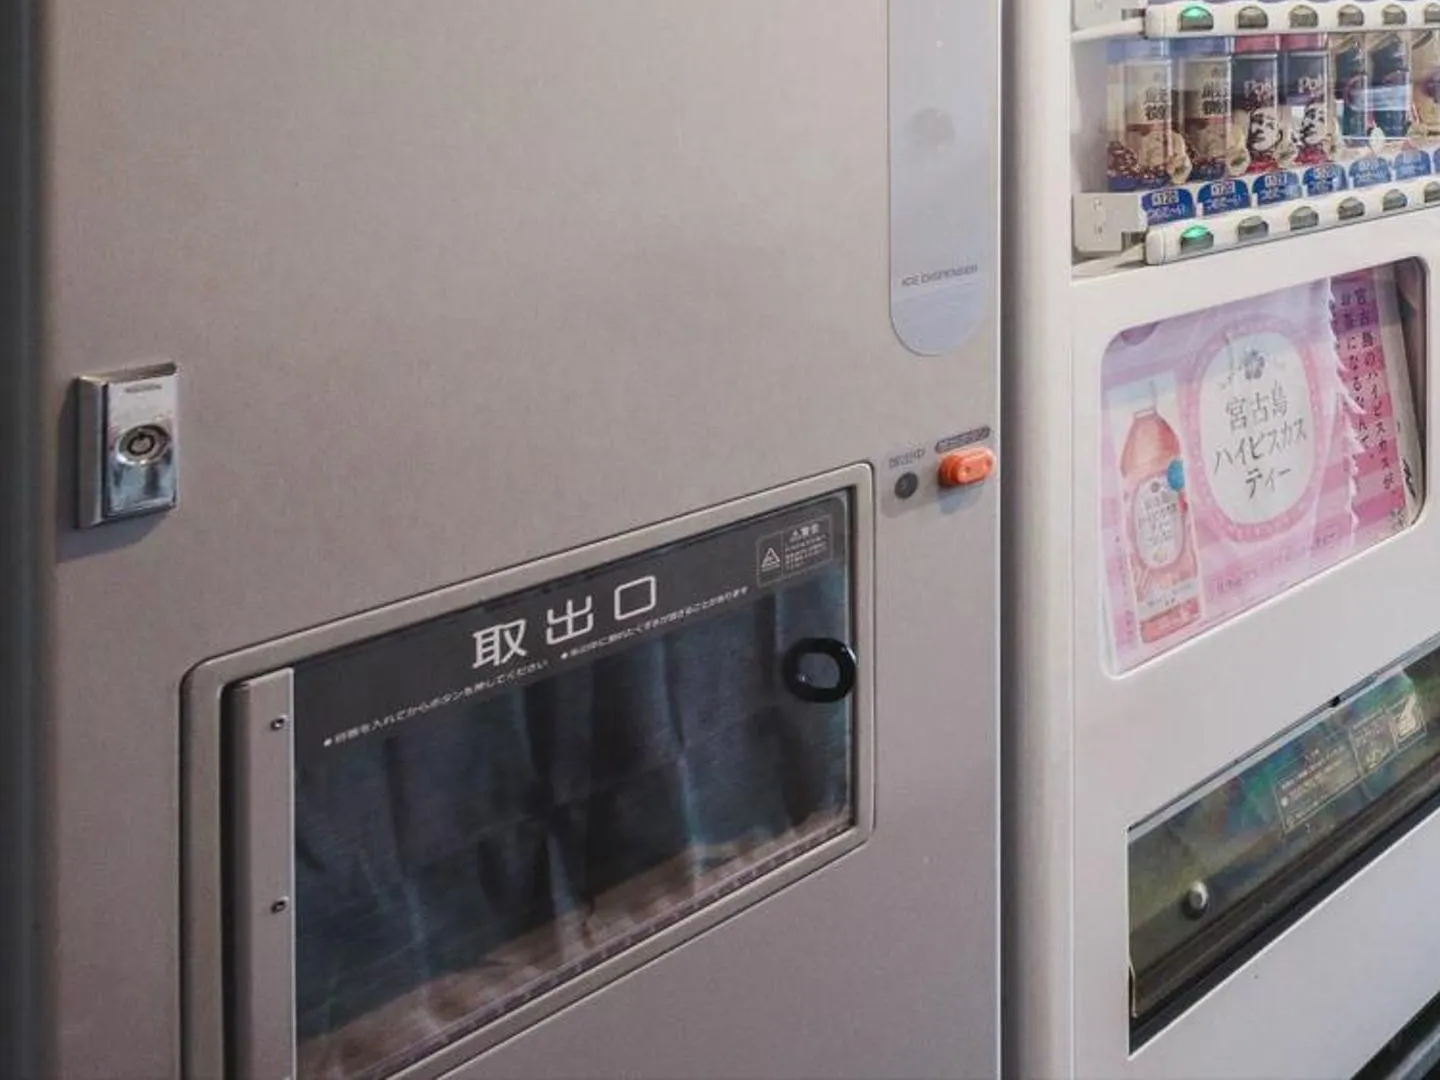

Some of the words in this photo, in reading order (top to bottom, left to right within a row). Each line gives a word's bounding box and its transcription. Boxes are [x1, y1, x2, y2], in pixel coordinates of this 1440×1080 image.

[902, 276, 920, 287] ICE
[1225, 386, 1289, 430] 宮古島
[1213, 418, 1307, 475] ハイビスカス
[1244, 467, 1291, 500] ティー
[472, 575, 658, 670] 取出口
